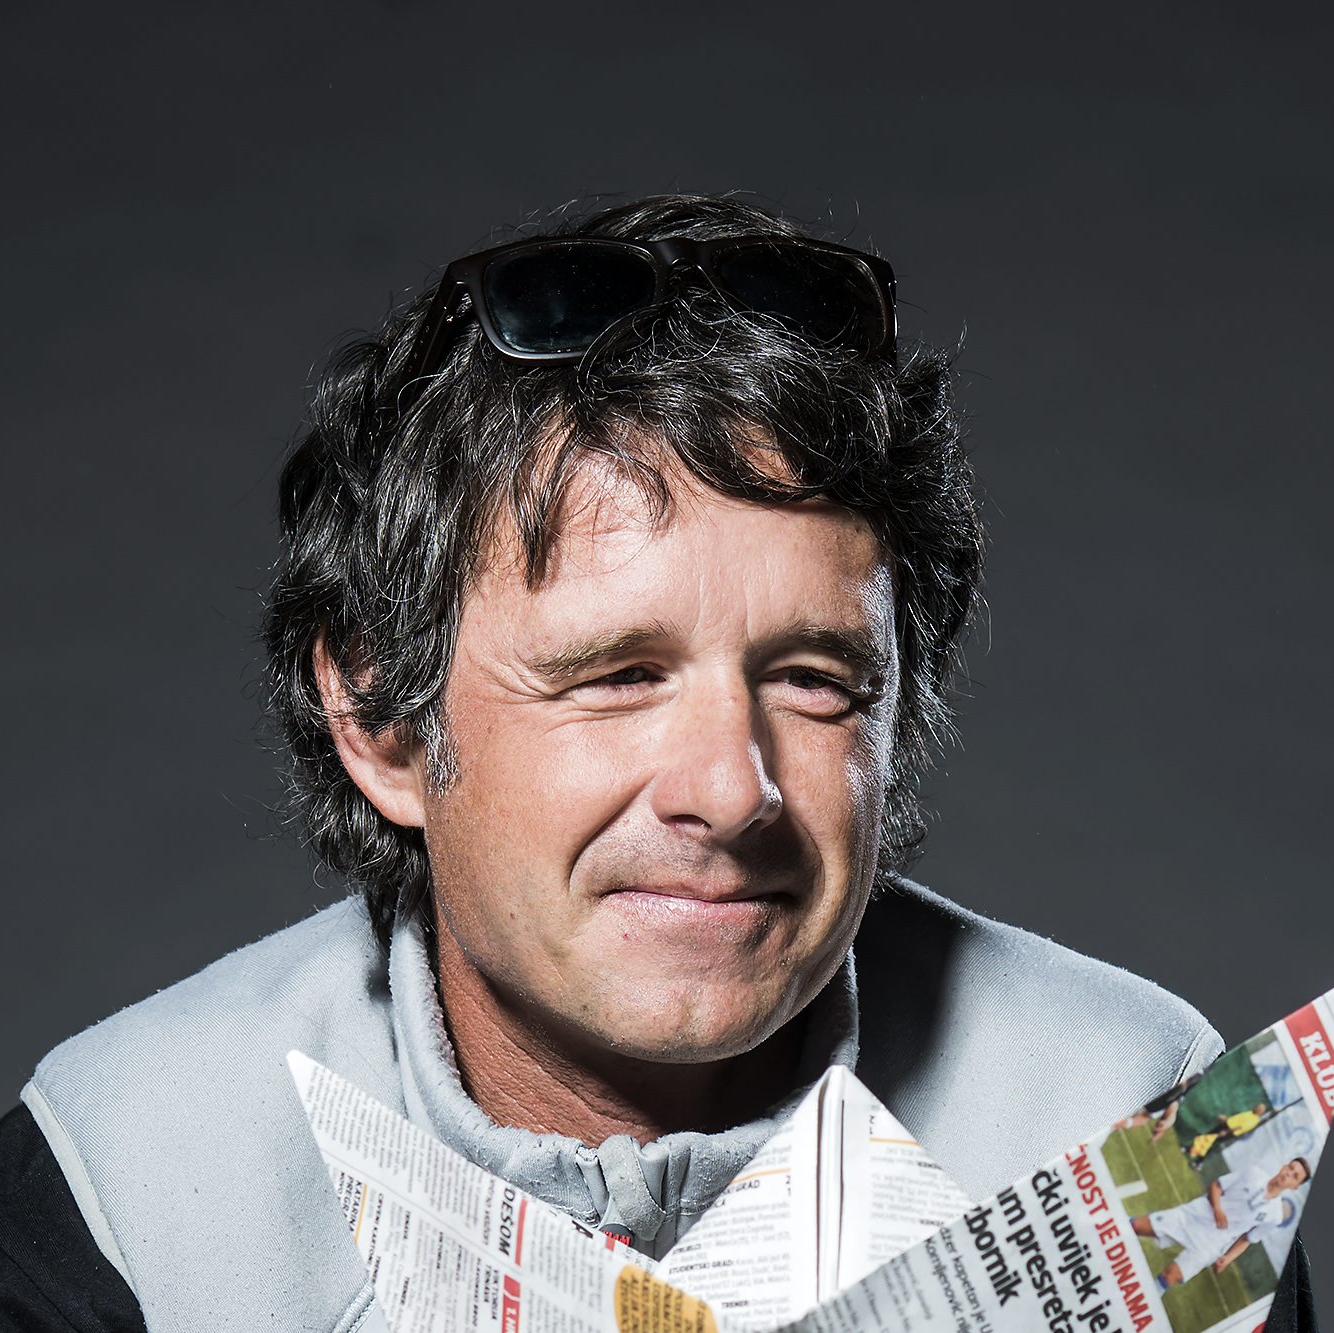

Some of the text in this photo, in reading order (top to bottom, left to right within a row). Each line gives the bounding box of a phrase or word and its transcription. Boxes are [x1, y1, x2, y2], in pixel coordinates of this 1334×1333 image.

[1045, 1216, 1102, 1302] uvijek
[1076, 1300, 1115, 1333] je
[1095, 1218, 1119, 1244] JE
[1105, 1242, 1154, 1331] DINAMA
